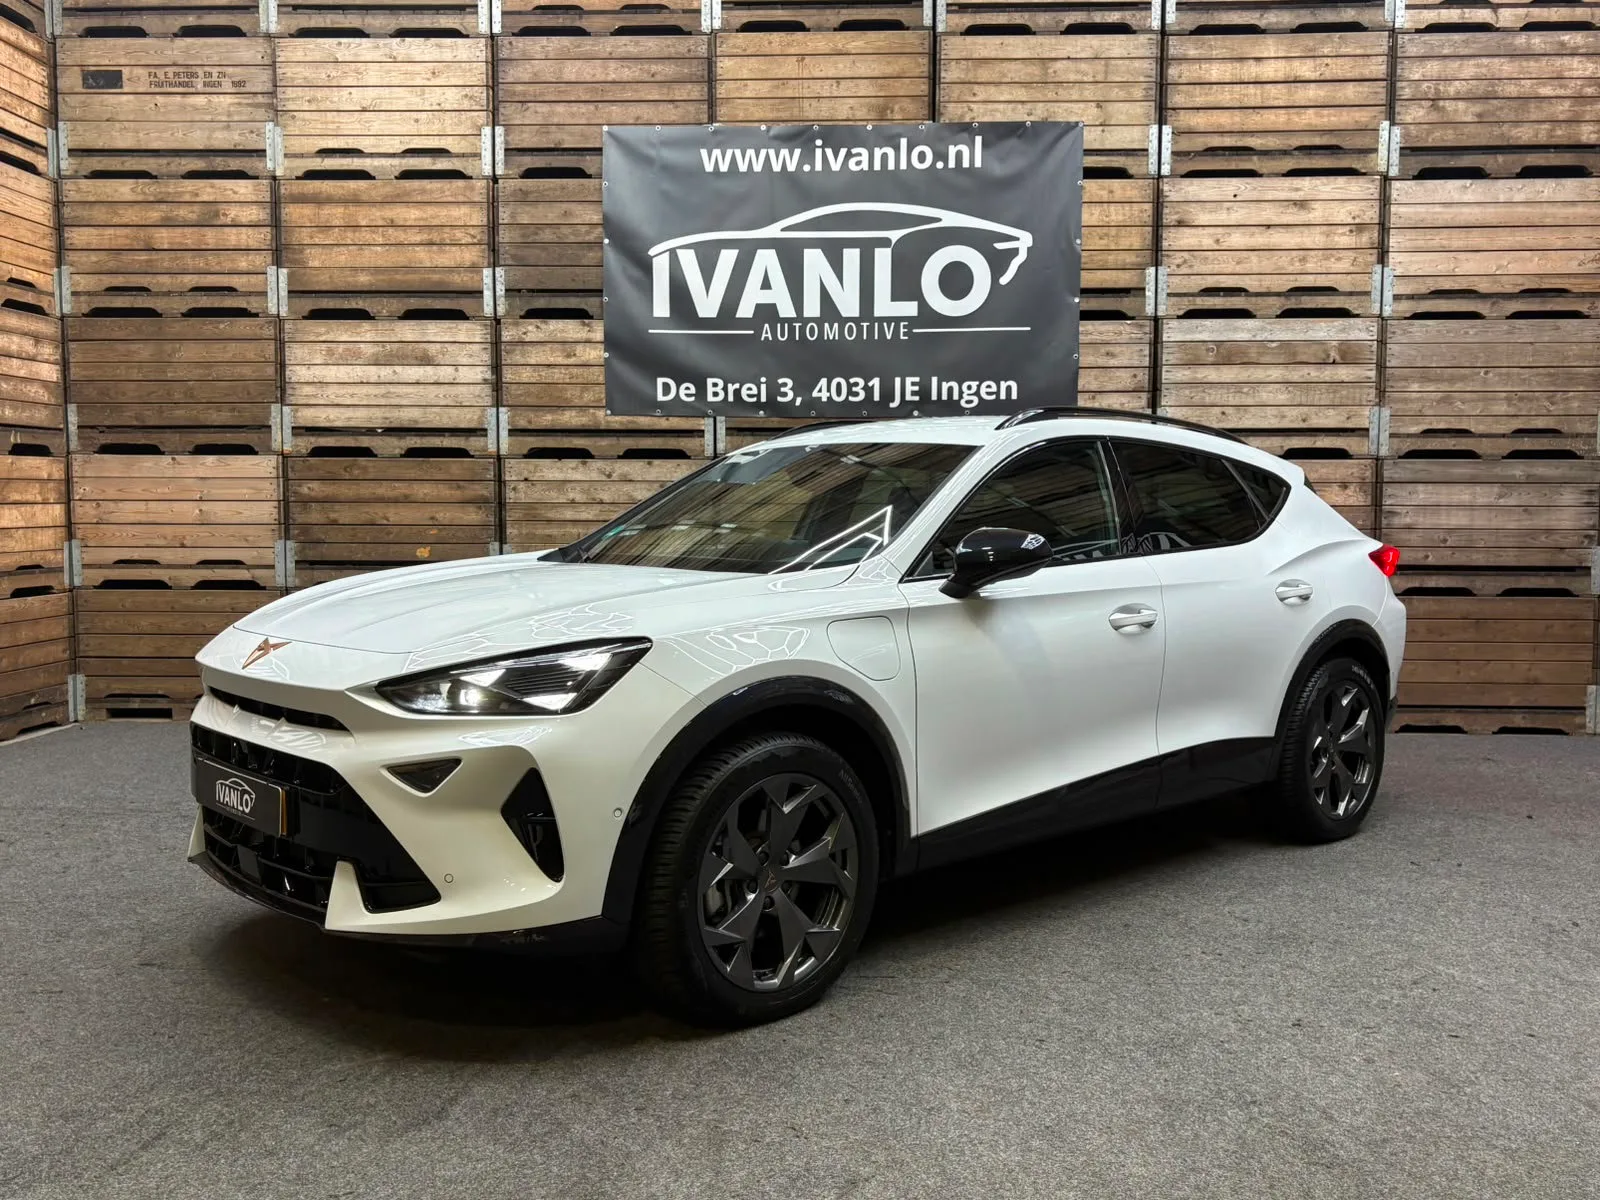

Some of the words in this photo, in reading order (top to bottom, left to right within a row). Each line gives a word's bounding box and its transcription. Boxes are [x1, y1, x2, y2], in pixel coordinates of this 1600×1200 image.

[173, 71, 199, 80] PETERS
[699, 135, 983, 173] www.ivanlo.nl
[651, 244, 992, 319] IVANLO
[760, 321, 910, 342] AUTOMOTIVE
[656, 377, 696, 402] De
[706, 376, 767, 403] Brei
[776, 377, 803, 406] 3,
[811, 377, 880, 402] 4031
[889, 376, 921, 408] JE
[931, 376, 1018, 409] Ingen
[216, 783, 251, 813] IVANLO
